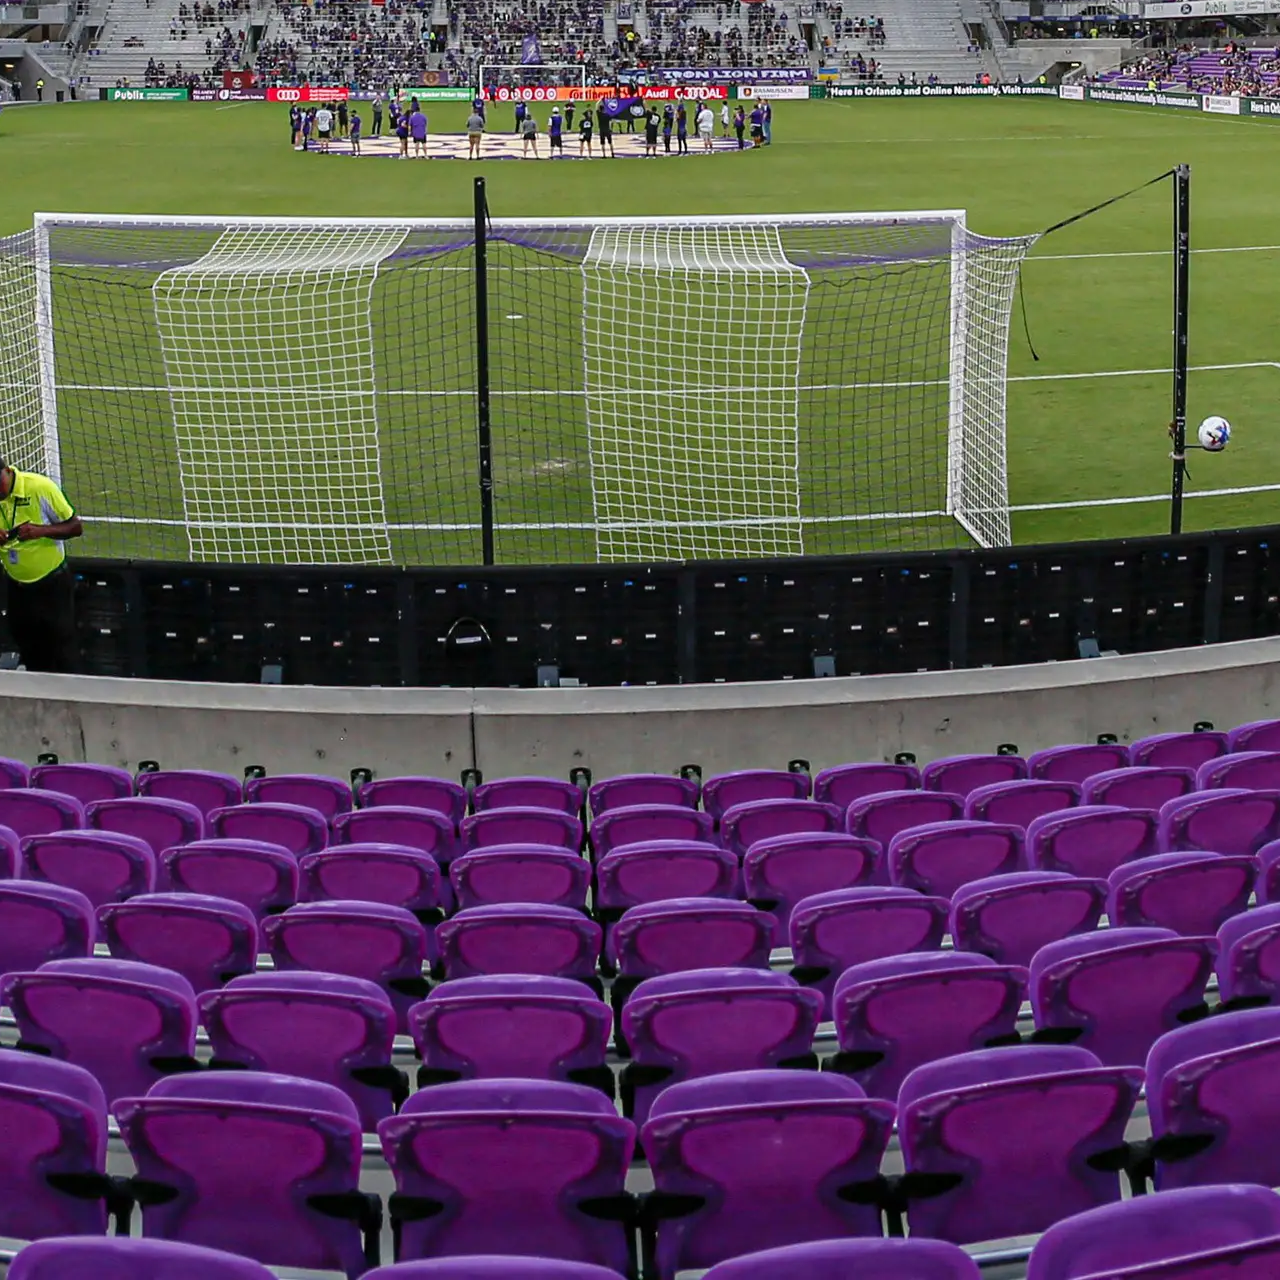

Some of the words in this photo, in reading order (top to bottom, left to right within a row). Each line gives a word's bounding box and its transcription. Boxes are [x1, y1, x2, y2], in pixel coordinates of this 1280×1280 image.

[761, 70, 808, 79] FIRM
[114, 90, 144, 100] Publix
[645, 88, 669, 98] Audi
[831, 87, 853, 97] Here
[854, 87, 863, 96] in
[865, 87, 902, 97] Orlando
[903, 87, 921, 96] and
[922, 87, 952, 96] Online
[953, 86, 1001, 97] Nationally.
[1001, 85, 1021, 95] Visit
[1250, 101, 1264, 113] Here
[1264, 102, 1270, 113] in
